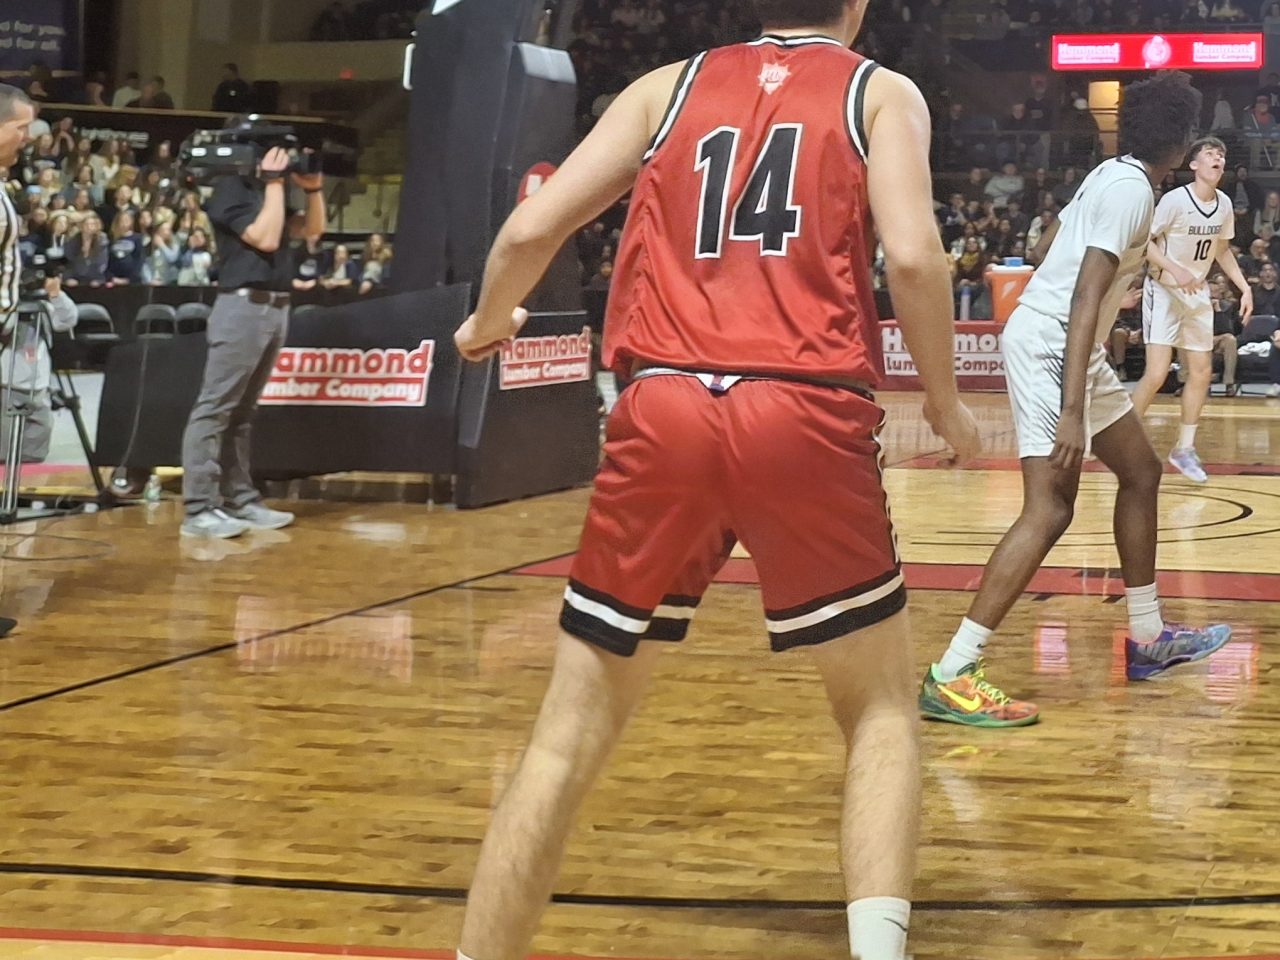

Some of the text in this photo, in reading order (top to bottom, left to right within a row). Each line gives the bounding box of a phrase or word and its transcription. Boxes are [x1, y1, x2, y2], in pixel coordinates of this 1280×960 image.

[693, 122, 803, 259] 14
[1194, 239, 1212, 261] 10
[276, 343, 430, 374] ammond
[325, 379, 420, 401] Company
